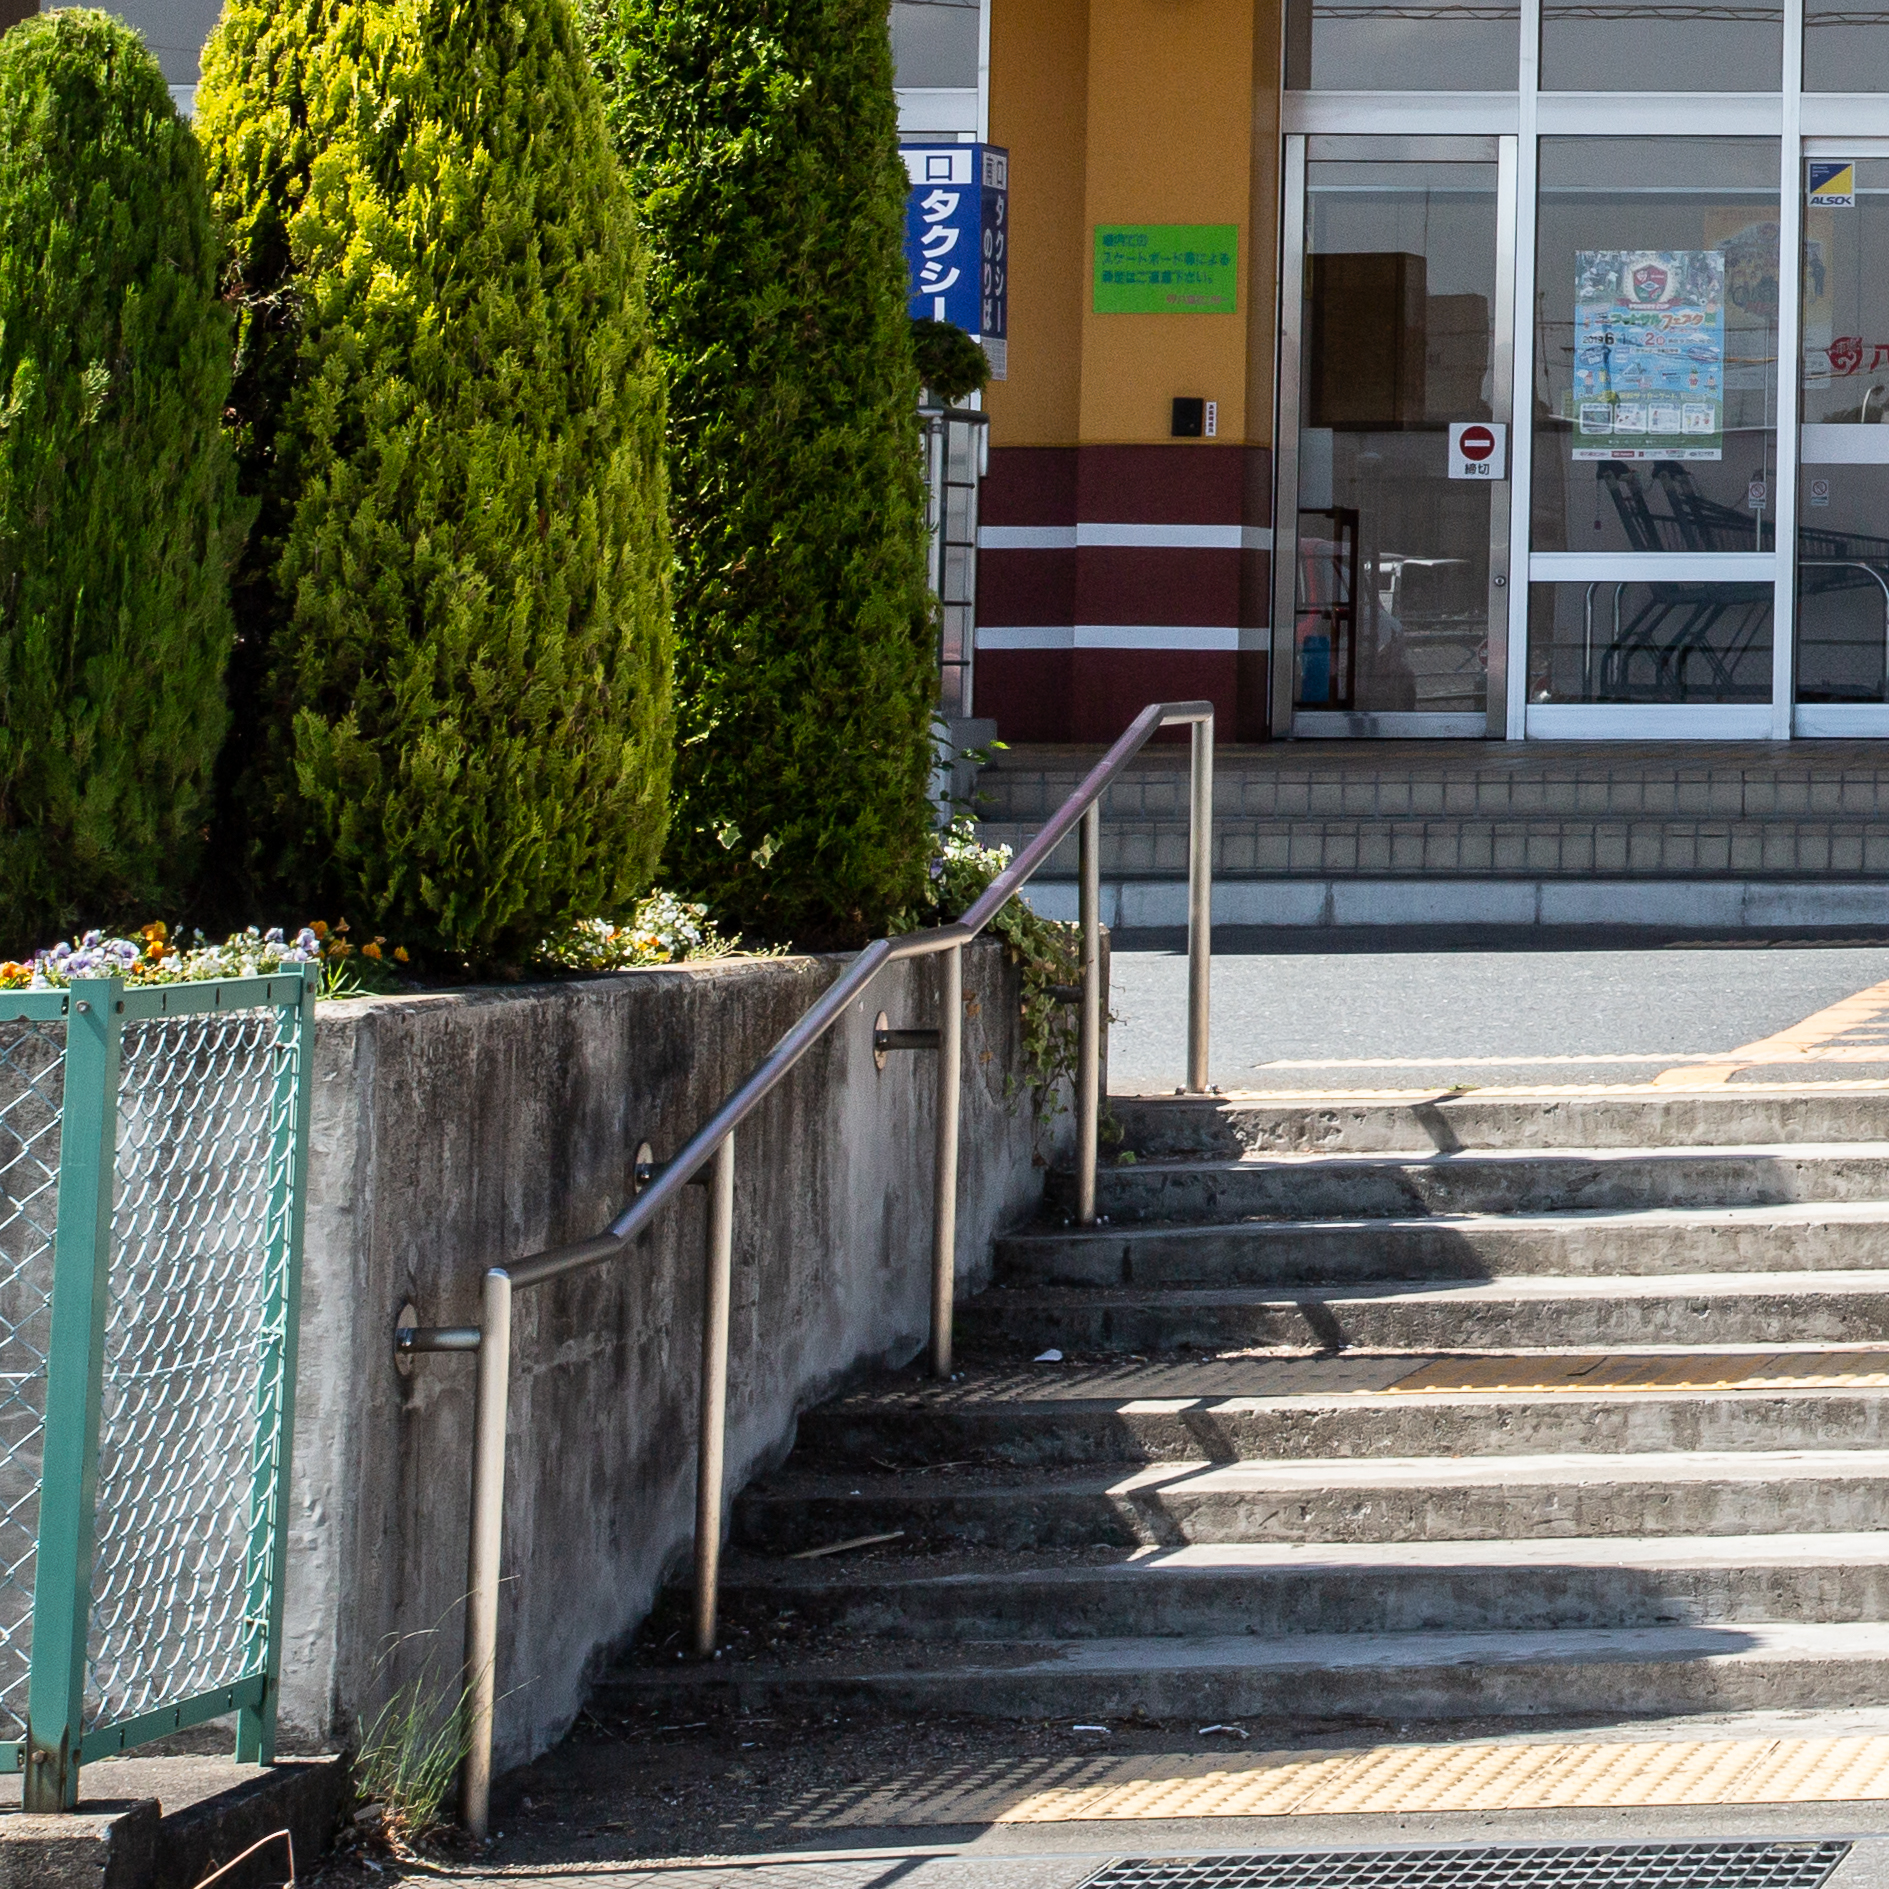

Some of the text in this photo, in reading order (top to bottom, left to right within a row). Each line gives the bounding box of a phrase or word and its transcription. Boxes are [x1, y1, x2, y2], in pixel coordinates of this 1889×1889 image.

[1810, 196, 1852, 205] ALSOK
[919, 189, 961, 323] タクシー
[1464, 463, 1491, 476] 締切
